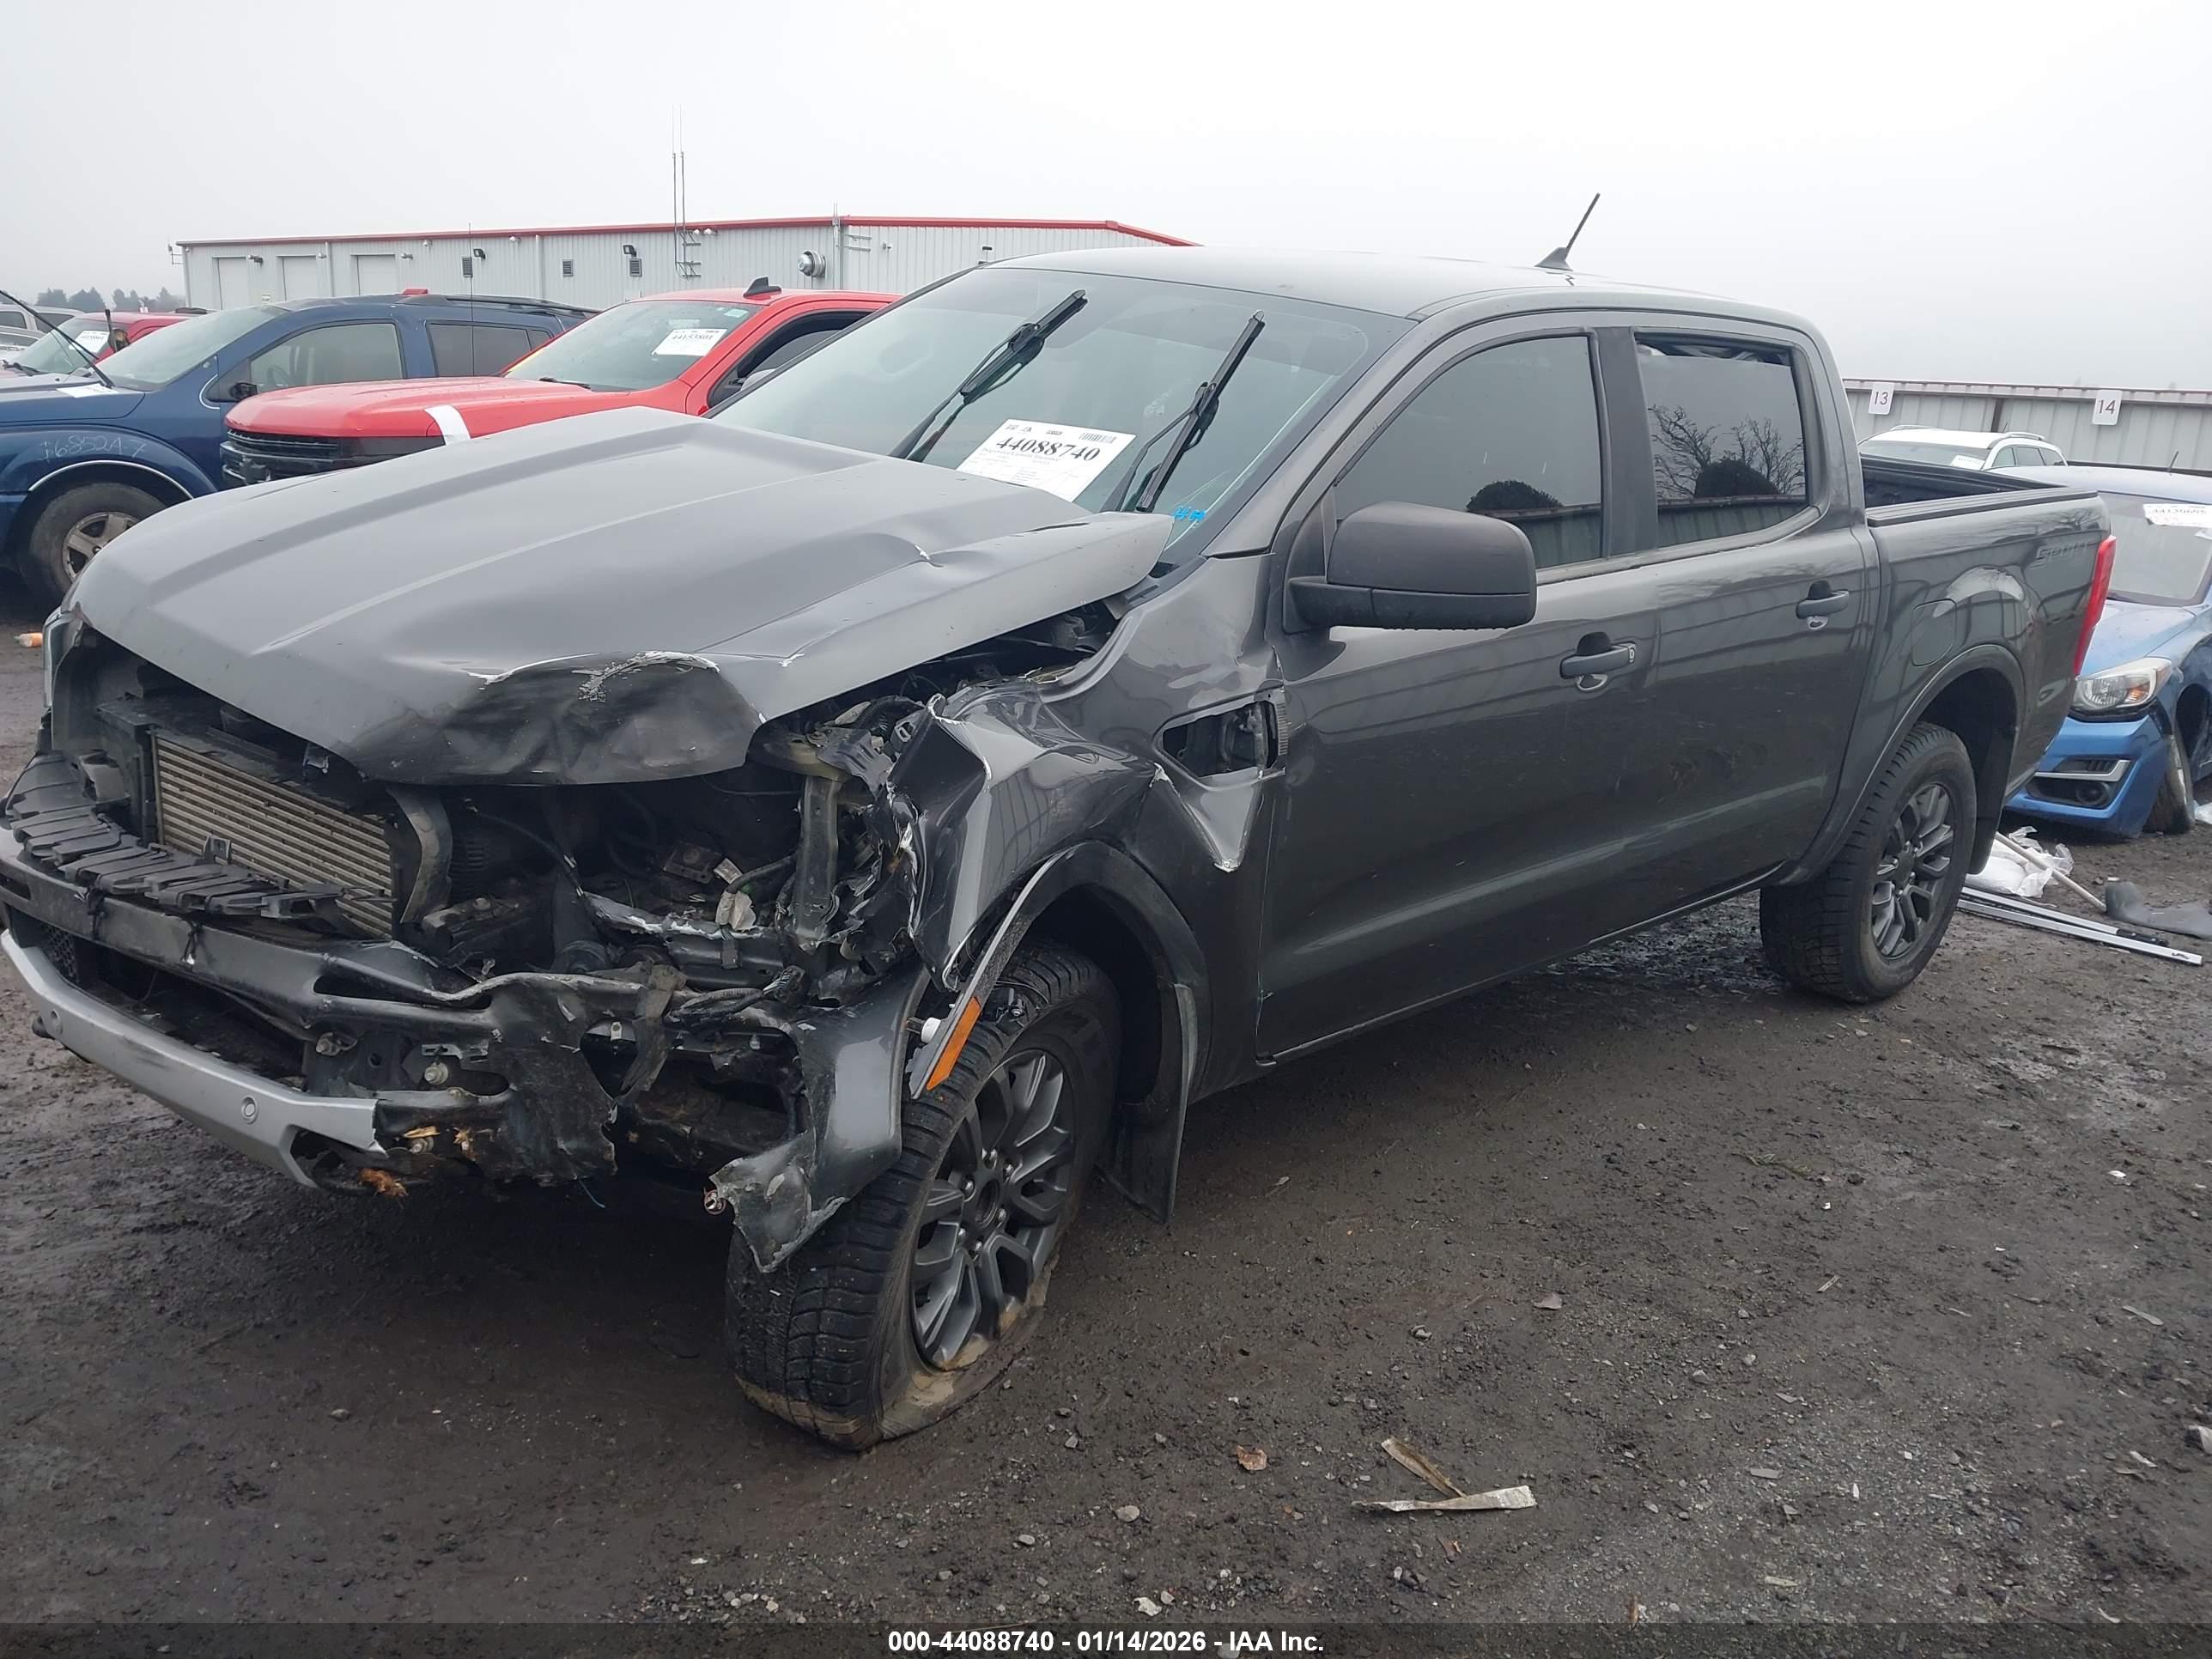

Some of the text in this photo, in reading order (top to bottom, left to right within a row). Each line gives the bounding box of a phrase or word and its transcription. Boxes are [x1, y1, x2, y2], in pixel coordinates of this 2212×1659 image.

[1875, 391, 1889, 405] 13
[2099, 399, 2116, 415] 14
[996, 436, 1102, 461] 44088740
